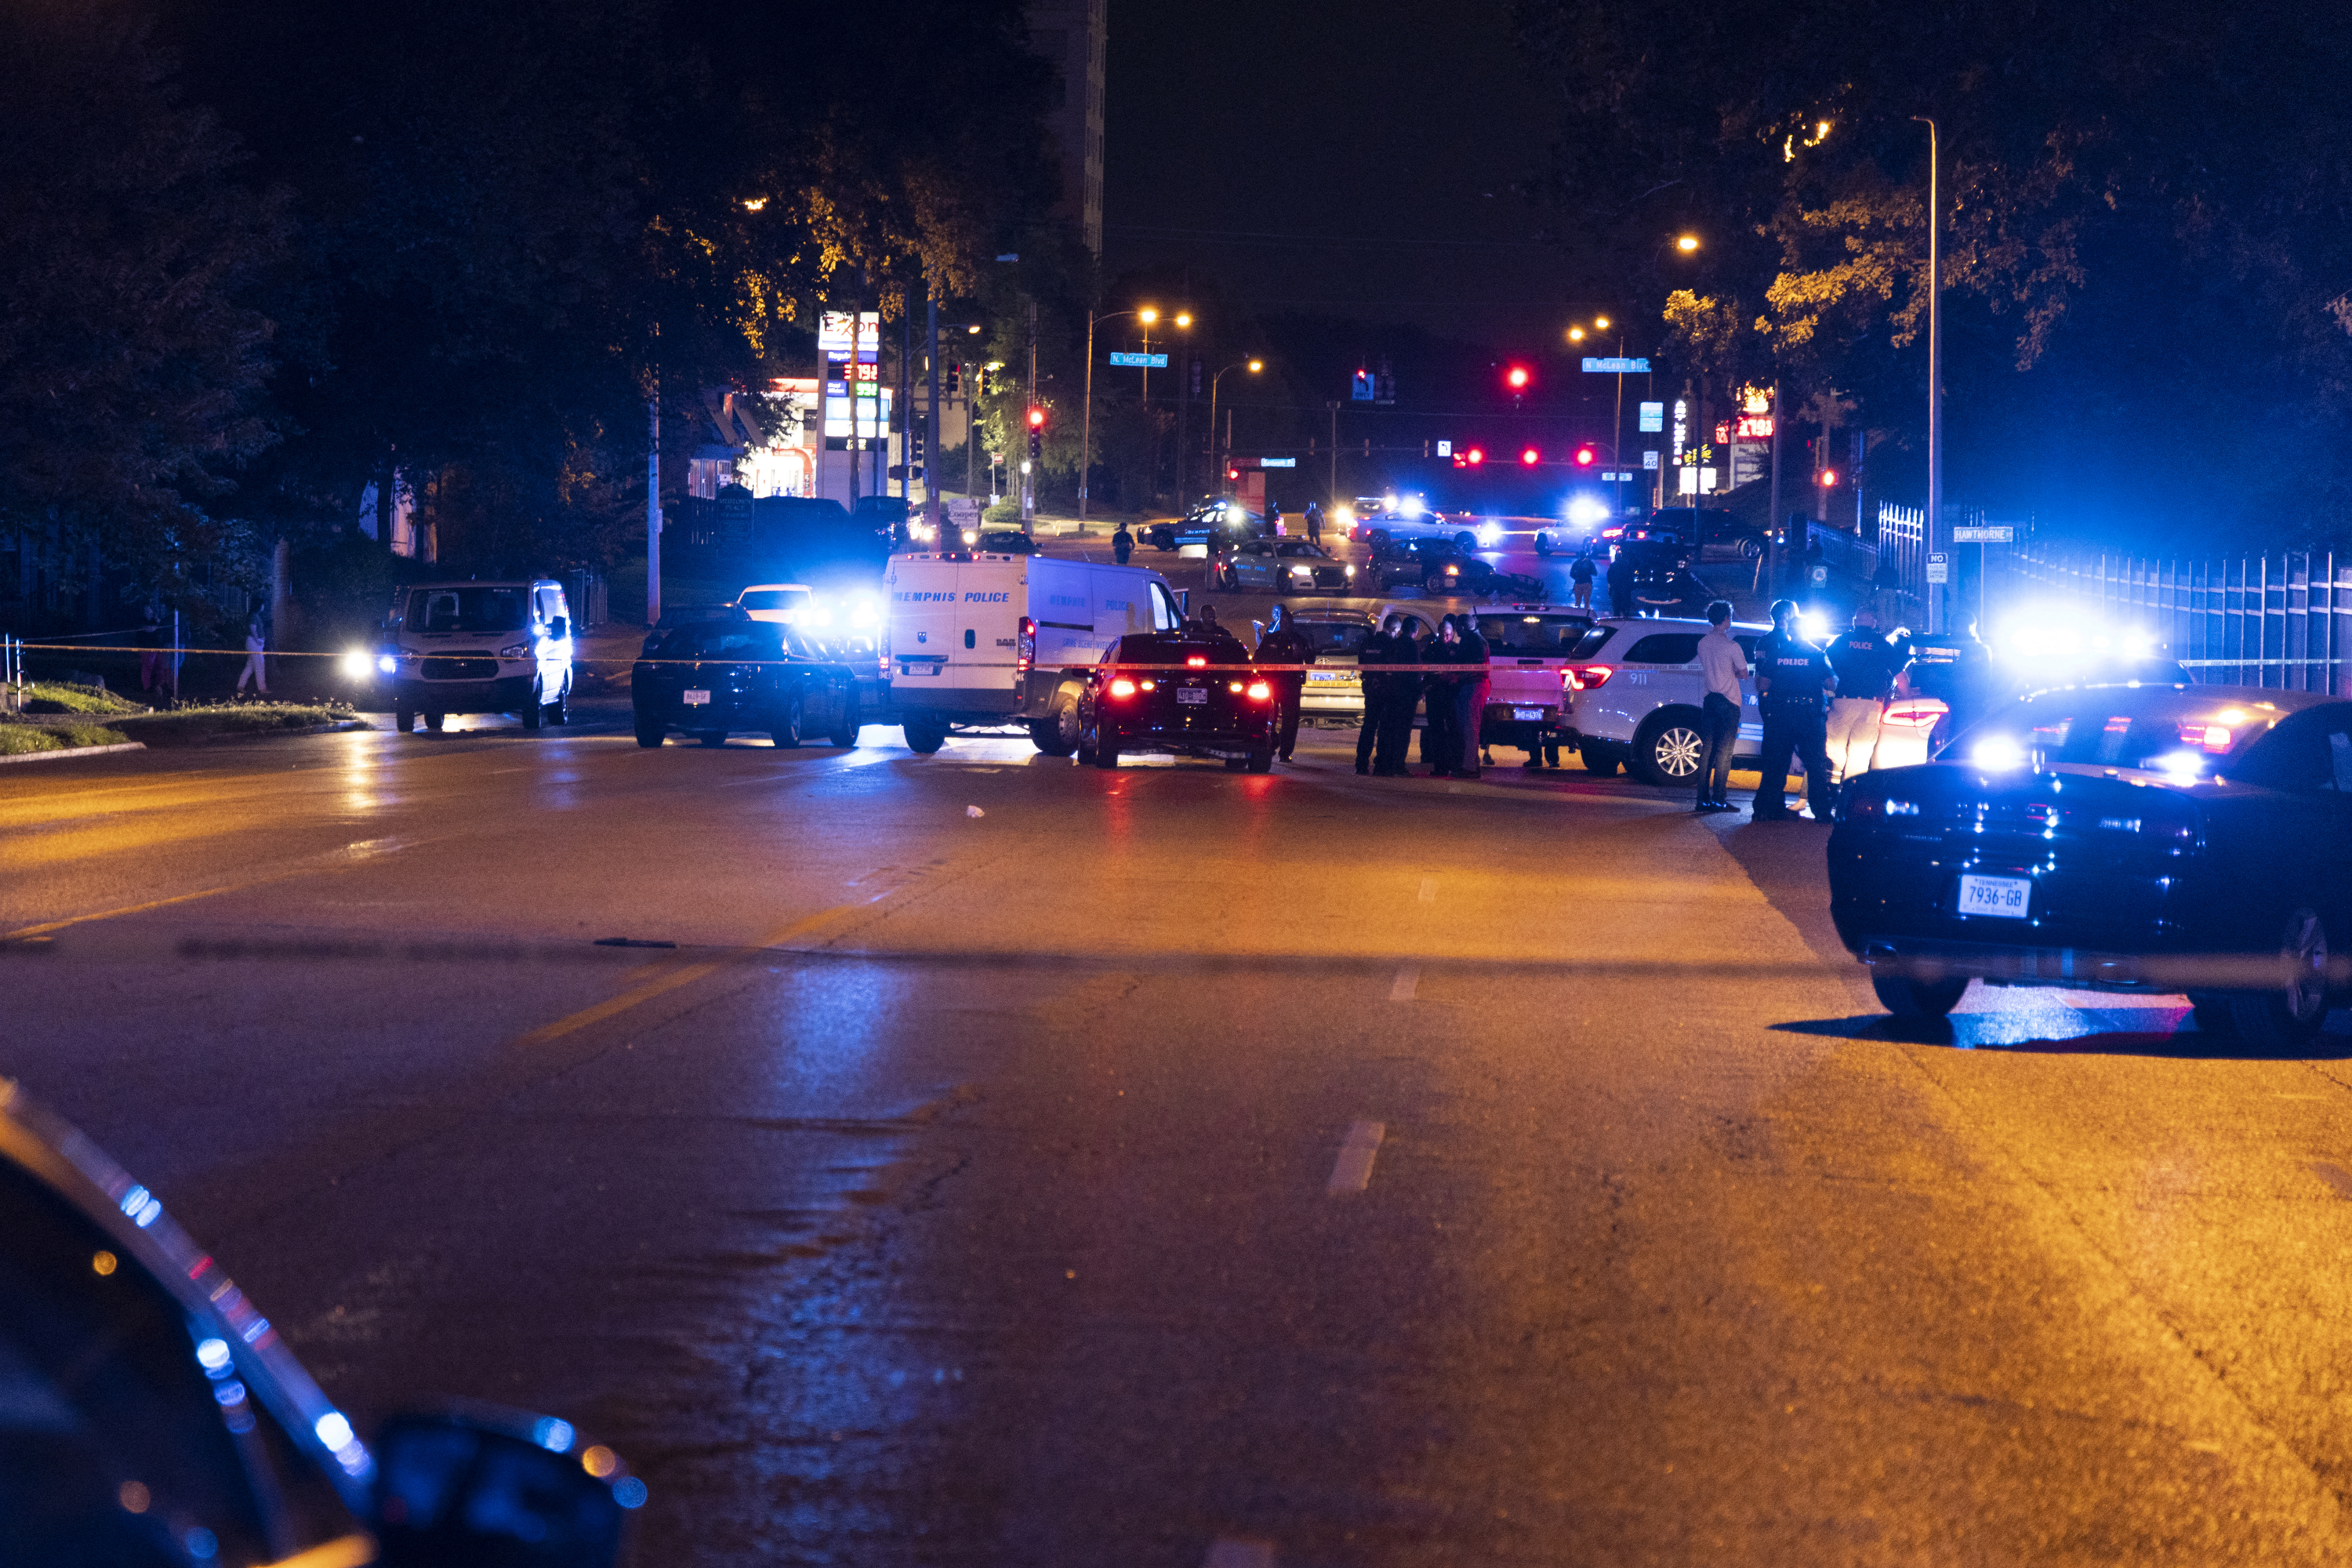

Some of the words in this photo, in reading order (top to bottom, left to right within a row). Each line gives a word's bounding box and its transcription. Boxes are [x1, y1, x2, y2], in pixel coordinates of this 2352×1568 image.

[1123, 355, 1147, 364] McLean
[1596, 361, 1626, 369] McLean
[949, 510, 978, 519] Cooper
[1955, 529, 2005, 539] HAWTHORNE
[892, 592, 956, 602] MEMPHIS
[964, 592, 1011, 603] POLICE
[1050, 595, 1086, 608] MEMPHIS
[1849, 641, 1873, 651] POLICE
[1777, 658, 1809, 666] POLICE
[1630, 673, 1647, 685] 911
[1979, 879, 2013, 887] TENNESSEE
[1969, 886, 2022, 906] 7936-GB
